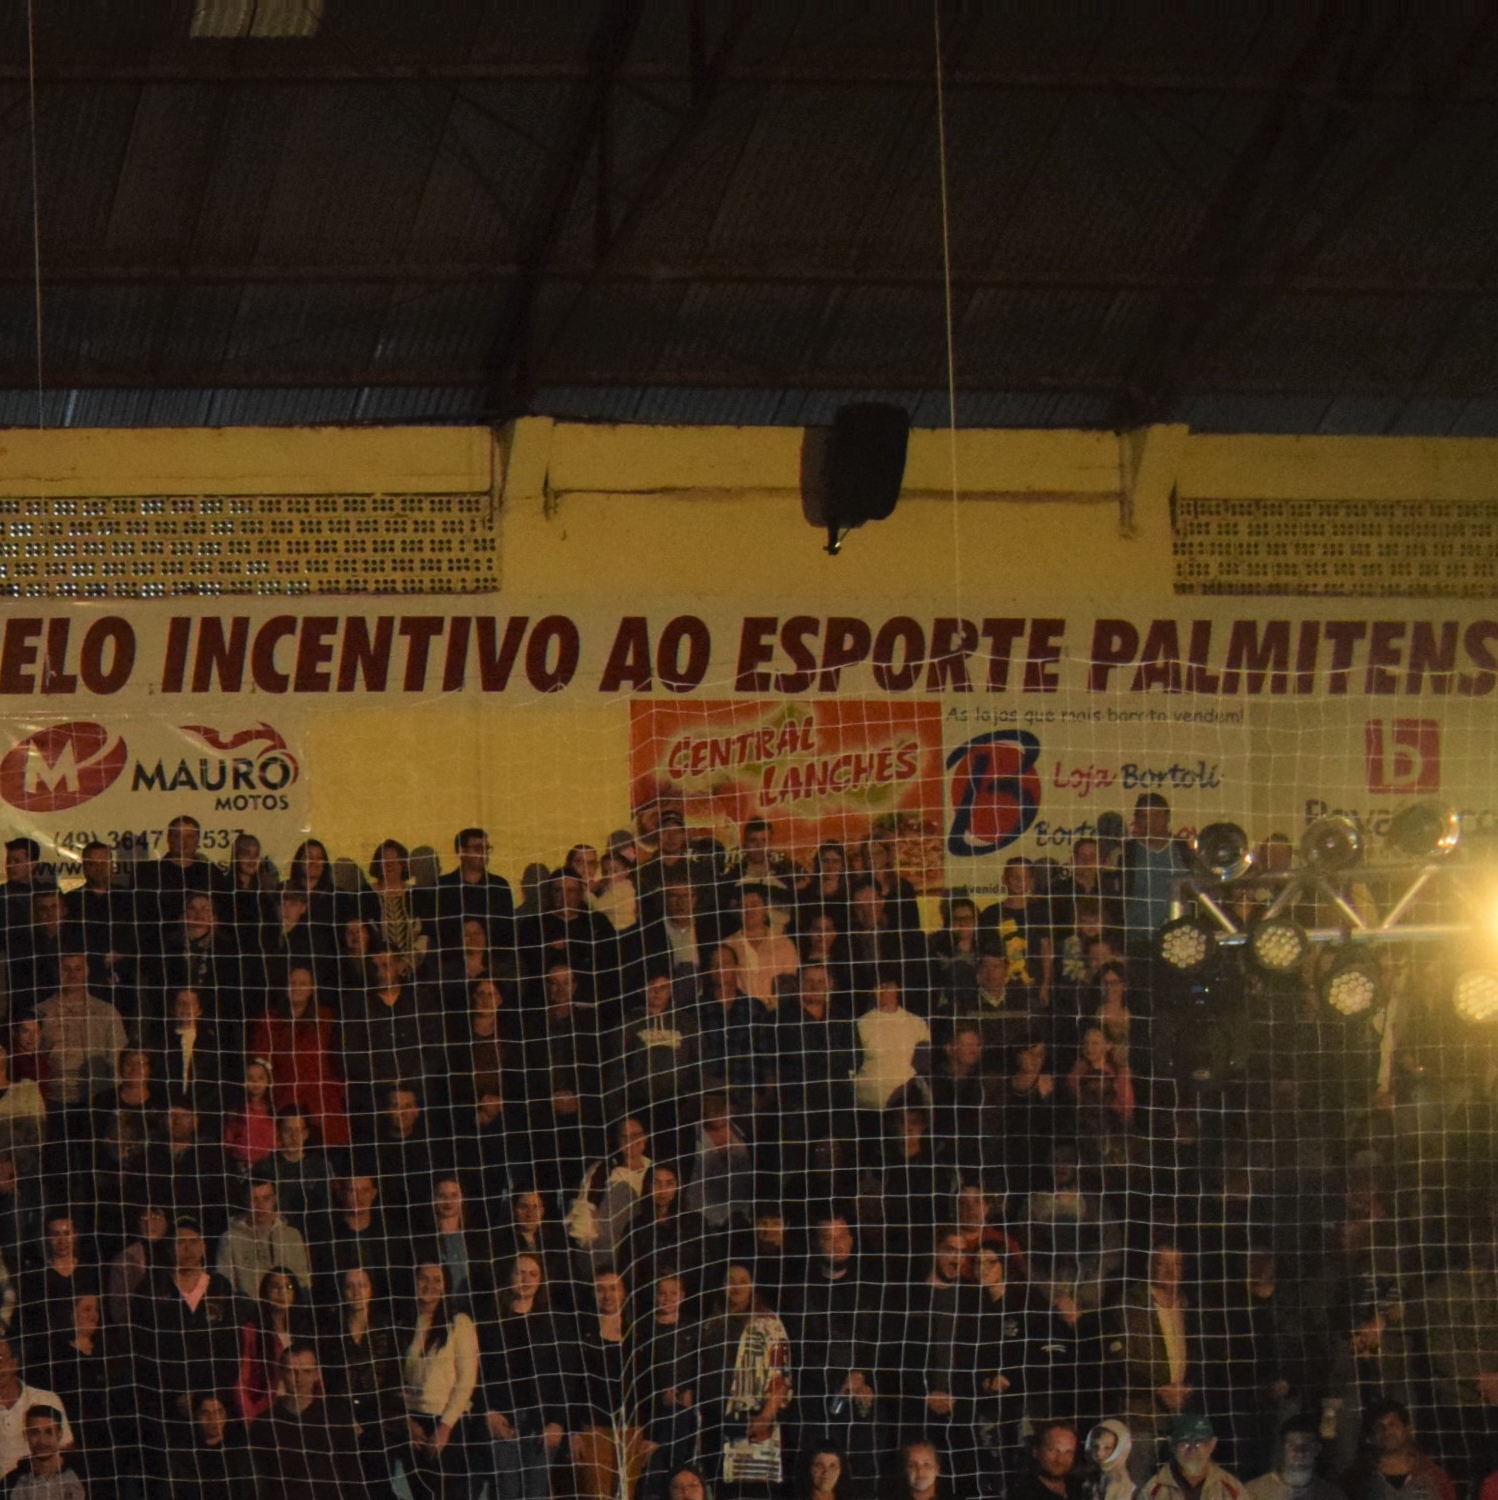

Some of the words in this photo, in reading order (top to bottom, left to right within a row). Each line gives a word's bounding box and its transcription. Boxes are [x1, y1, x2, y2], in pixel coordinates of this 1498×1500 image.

[160, 615, 582, 695] INCENTIVO
[598, 615, 712, 694] AO
[734, 615, 1068, 694] ESPORTE
[1024, 710, 1055, 726] que
[667, 715, 817, 780] CENTRAL
[131, 755, 292, 792] MAURO
[759, 740, 919, 808] LANCHES
[1054, 761, 1117, 798] Loja
[1121, 760, 1221, 789] Bortoli
[214, 794, 290, 811] MOTOS
